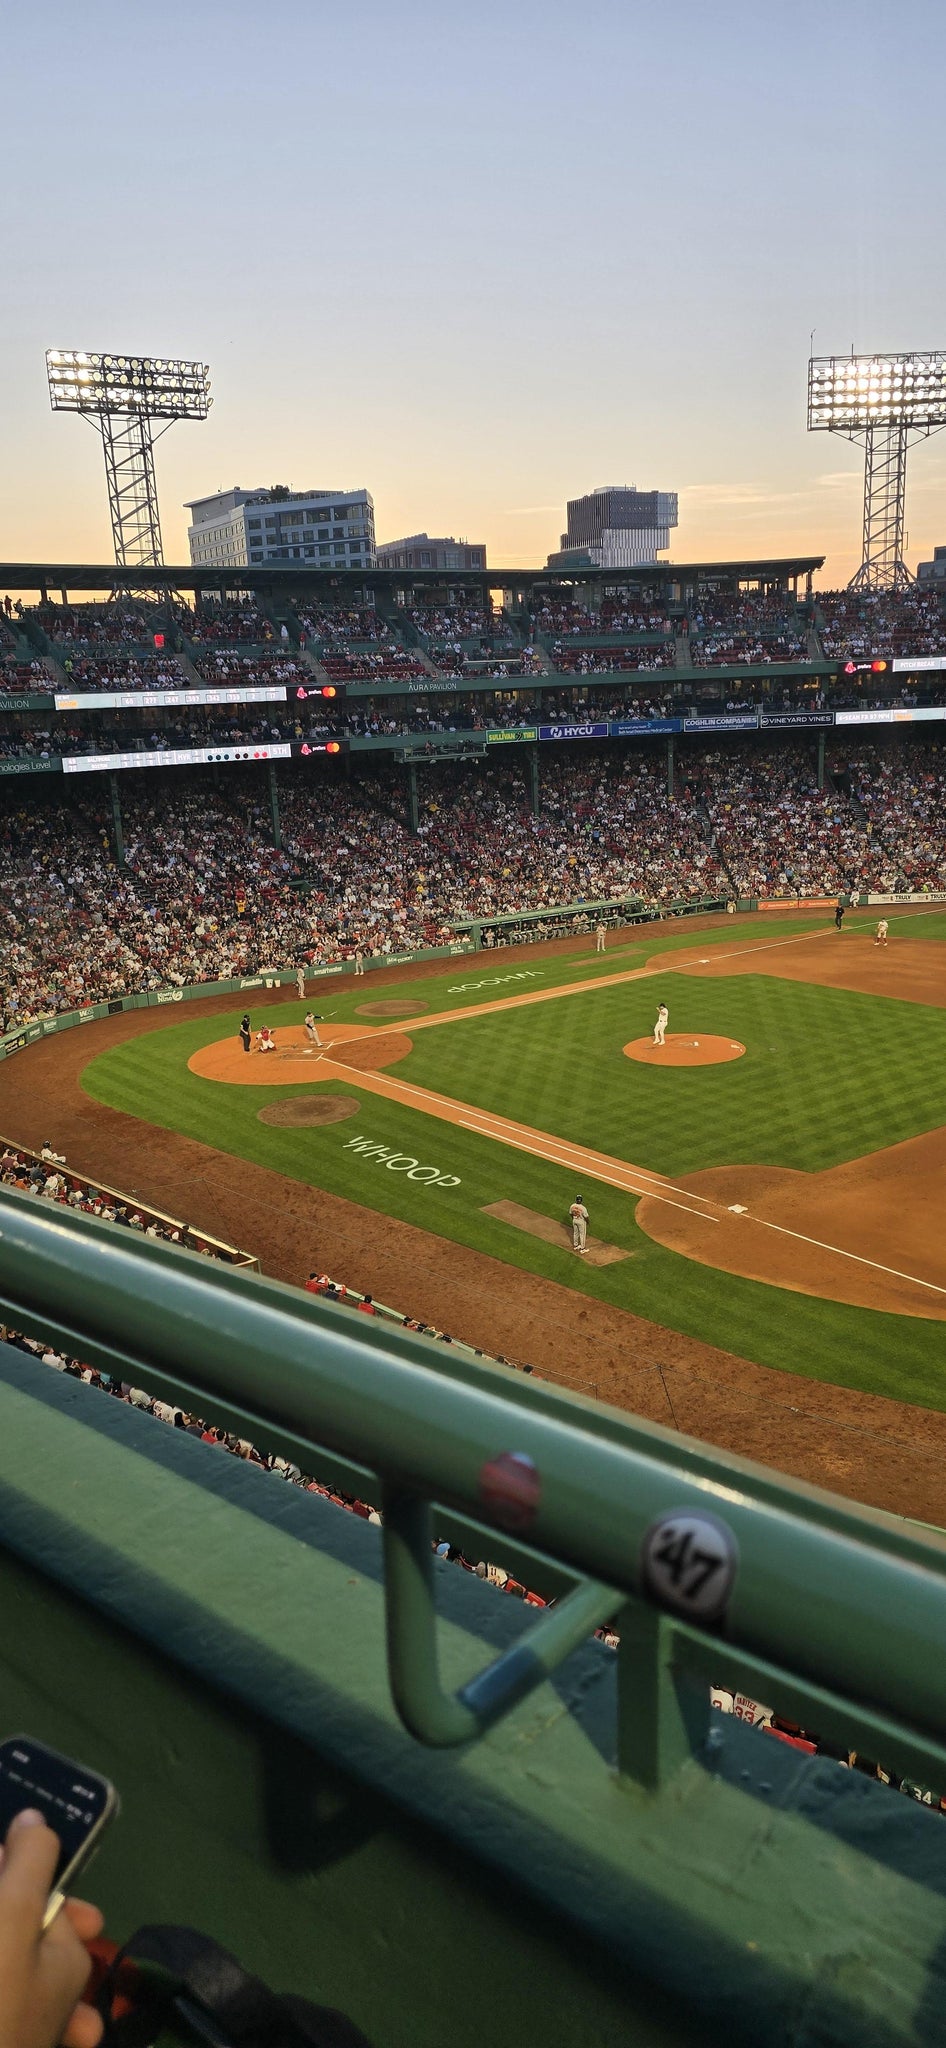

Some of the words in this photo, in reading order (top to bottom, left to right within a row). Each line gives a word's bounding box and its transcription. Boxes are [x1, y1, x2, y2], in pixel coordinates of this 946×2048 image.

[429, 682, 457, 690] PAVILION
[716, 717, 757, 725] COMPANIES
[769, 716, 807, 724] VINEYARD
[488, 732, 515, 741] SULLIVAN
[523, 731, 535, 739] TIRE
[564, 726, 593, 736] HYCU
[31, 760, 52, 770] Level
[313, 966, 343, 976] smartwater
[447, 970, 545, 993] WHOOP
[342, 1135, 462, 1188] WHOOP
[913, 1787, 932, 1804] 34
